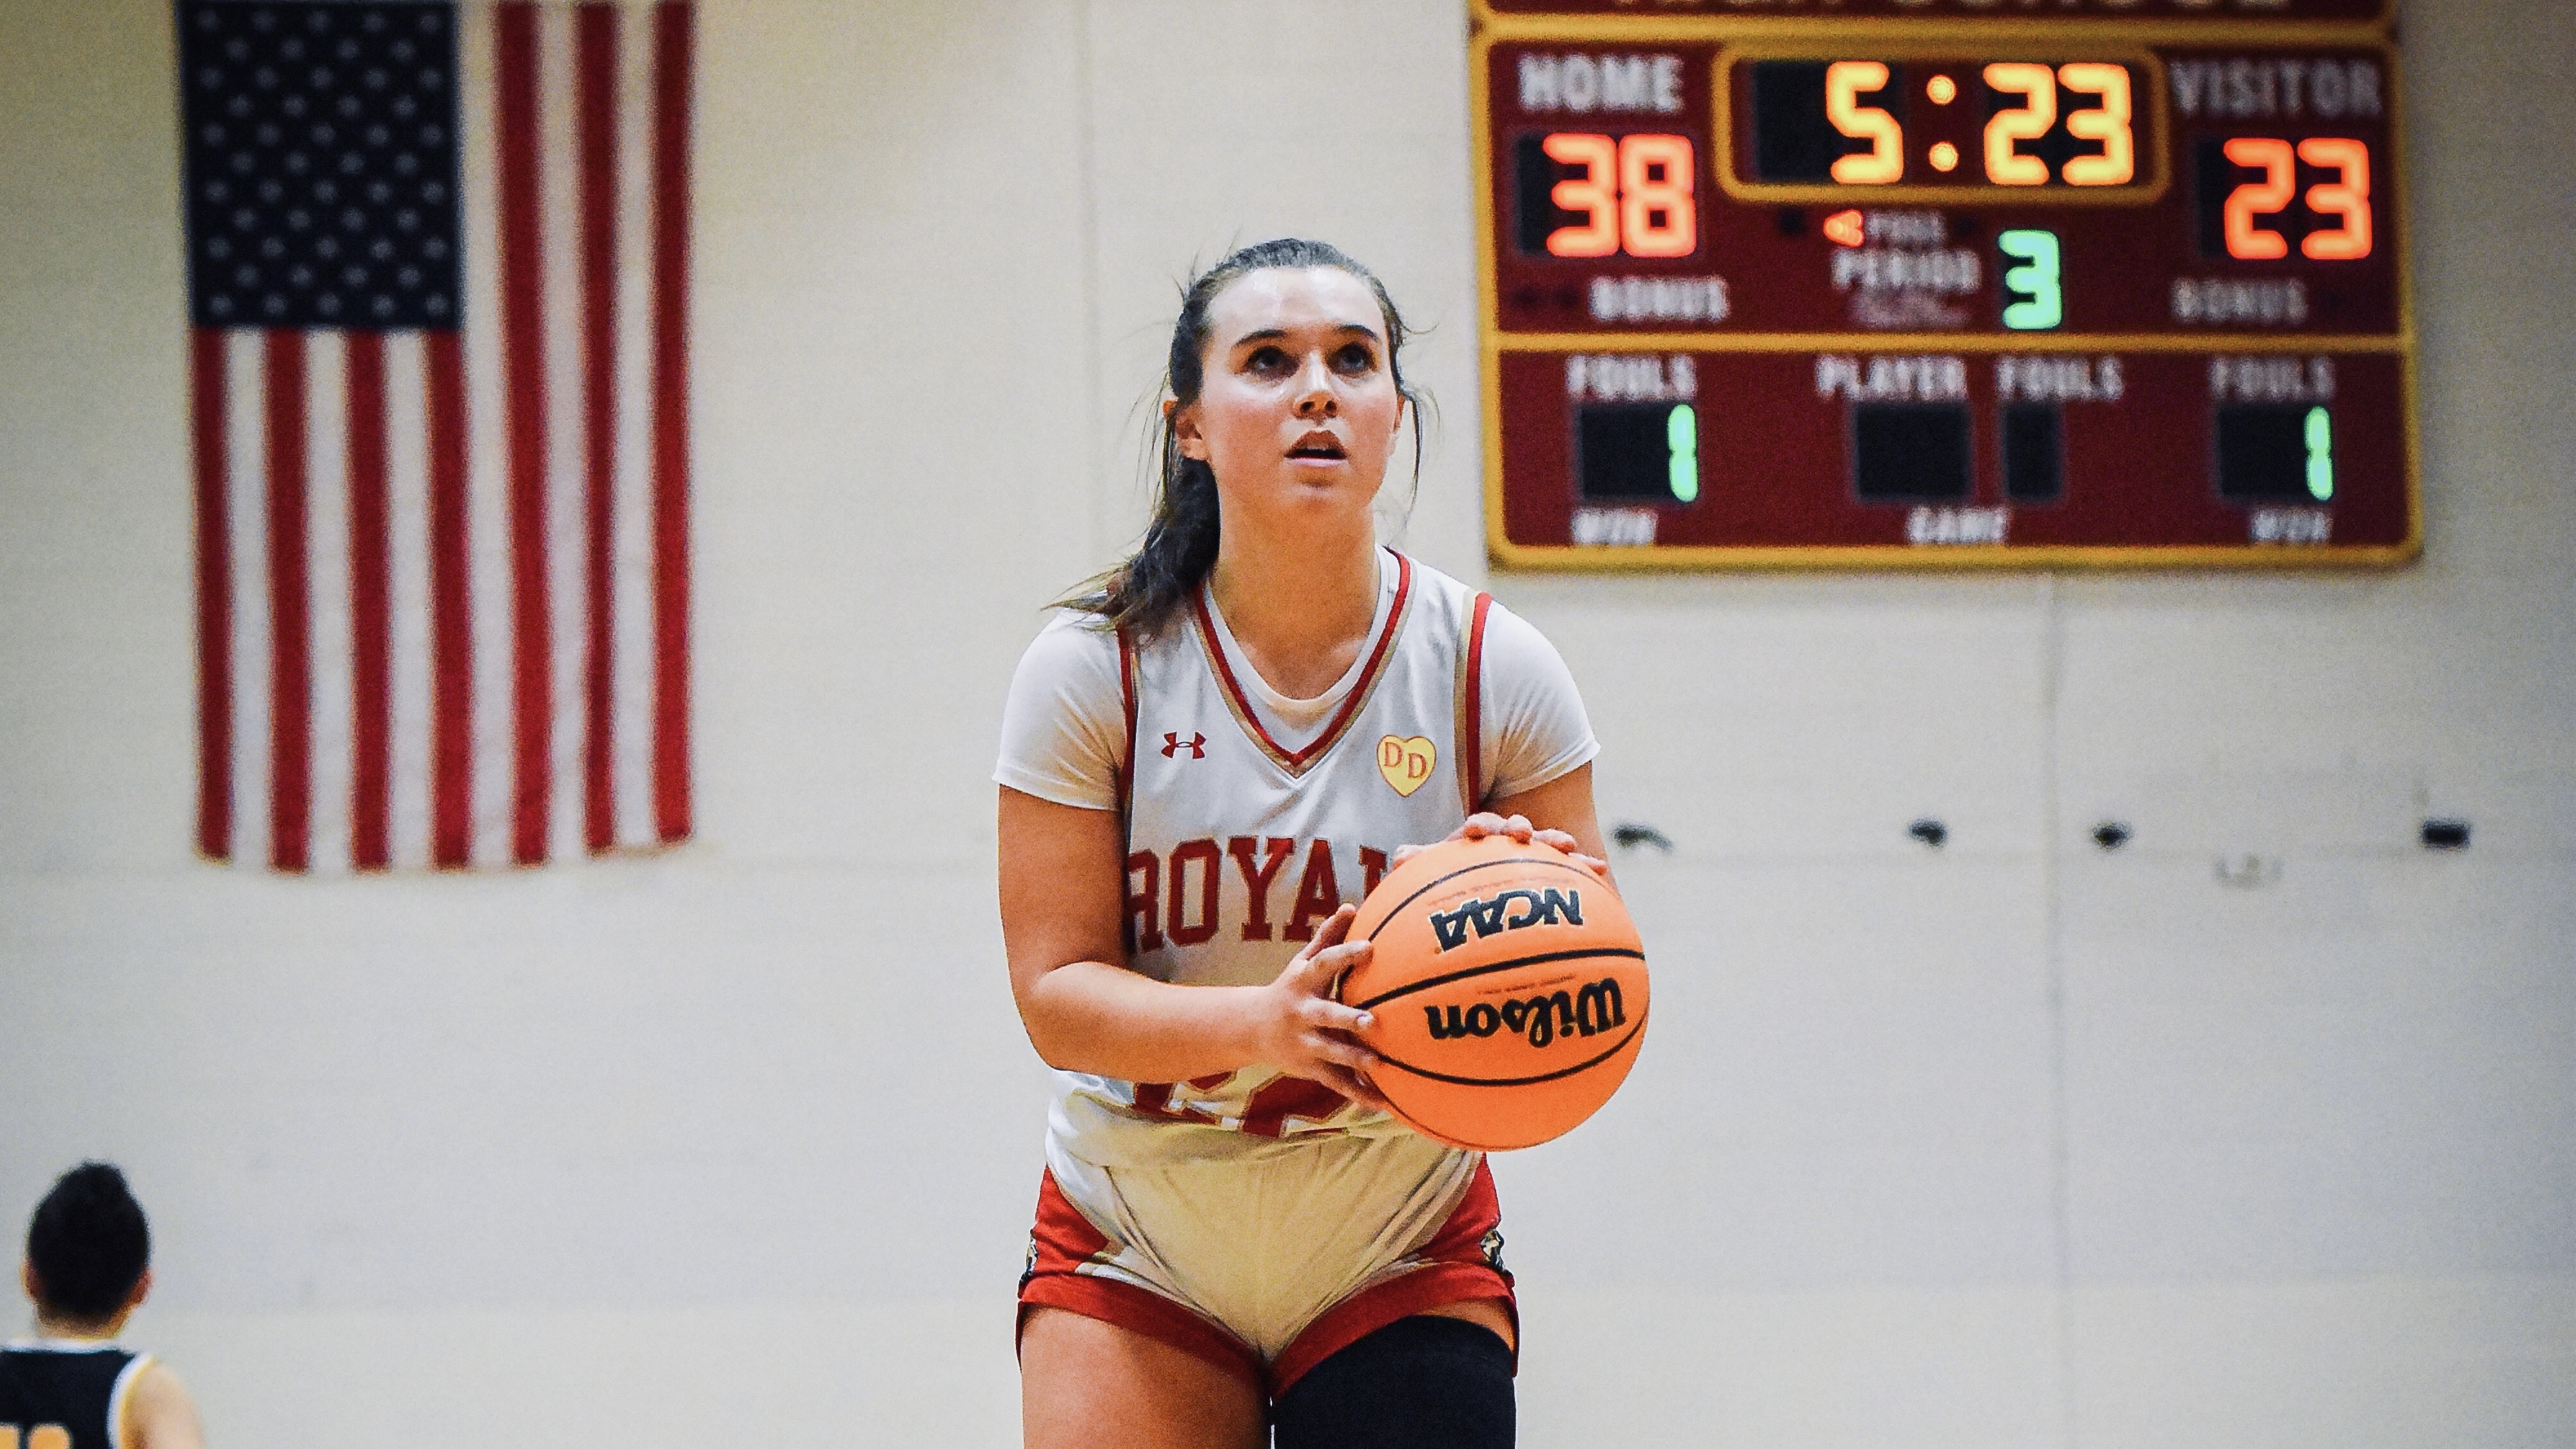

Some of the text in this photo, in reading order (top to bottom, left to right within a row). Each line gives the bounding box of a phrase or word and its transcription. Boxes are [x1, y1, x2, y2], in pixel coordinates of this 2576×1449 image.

[1517, 54, 1684, 112] HOME
[2170, 59, 2383, 118] VISITOR
[1826, 61, 2134, 187] 5:23
[1543, 133, 1697, 257] 38
[2223, 137, 2373, 260] 23
[1589, 275, 1730, 322] BONUS
[1831, 249, 1982, 291] PERIOD
[1998, 229, 2062, 329] 3
[2170, 277, 2308, 322] BONUS
[1566, 355, 1697, 400] FOULS
[1815, 355, 2123, 401] PLAYER FOULS
[2207, 356, 2336, 401] FOULS
[1668, 404, 1699, 502] 1
[2304, 406, 2334, 501] 1
[1429, 886, 1585, 953] NCAA
[1423, 978, 1626, 1048] Wilson
